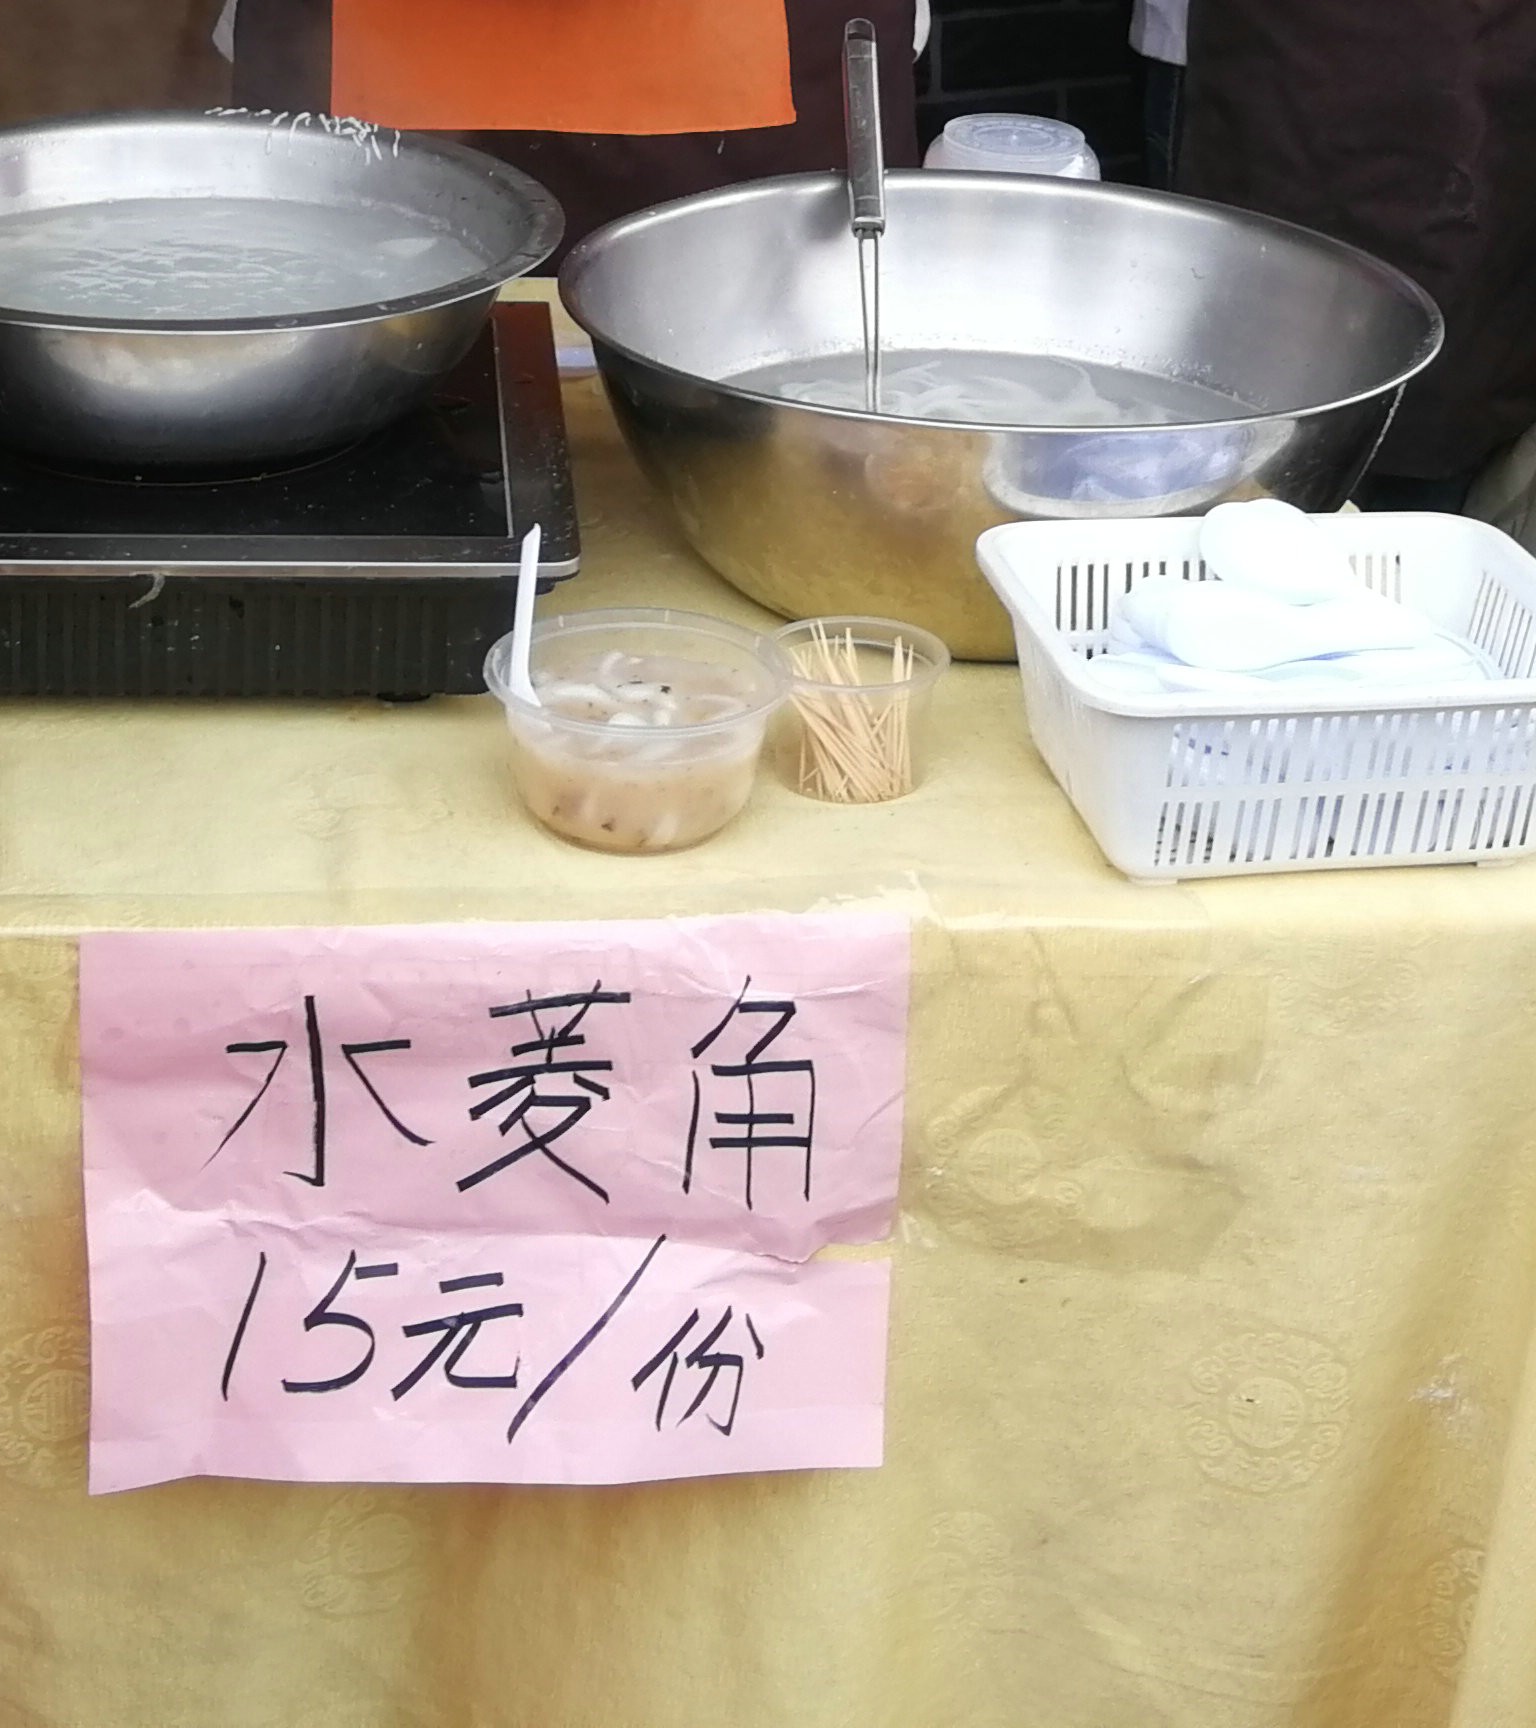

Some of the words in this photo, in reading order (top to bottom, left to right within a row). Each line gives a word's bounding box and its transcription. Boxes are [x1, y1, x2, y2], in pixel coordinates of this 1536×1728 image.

[201, 974, 818, 1210] 水菱角
[221, 1233, 765, 1444] 15元/份
